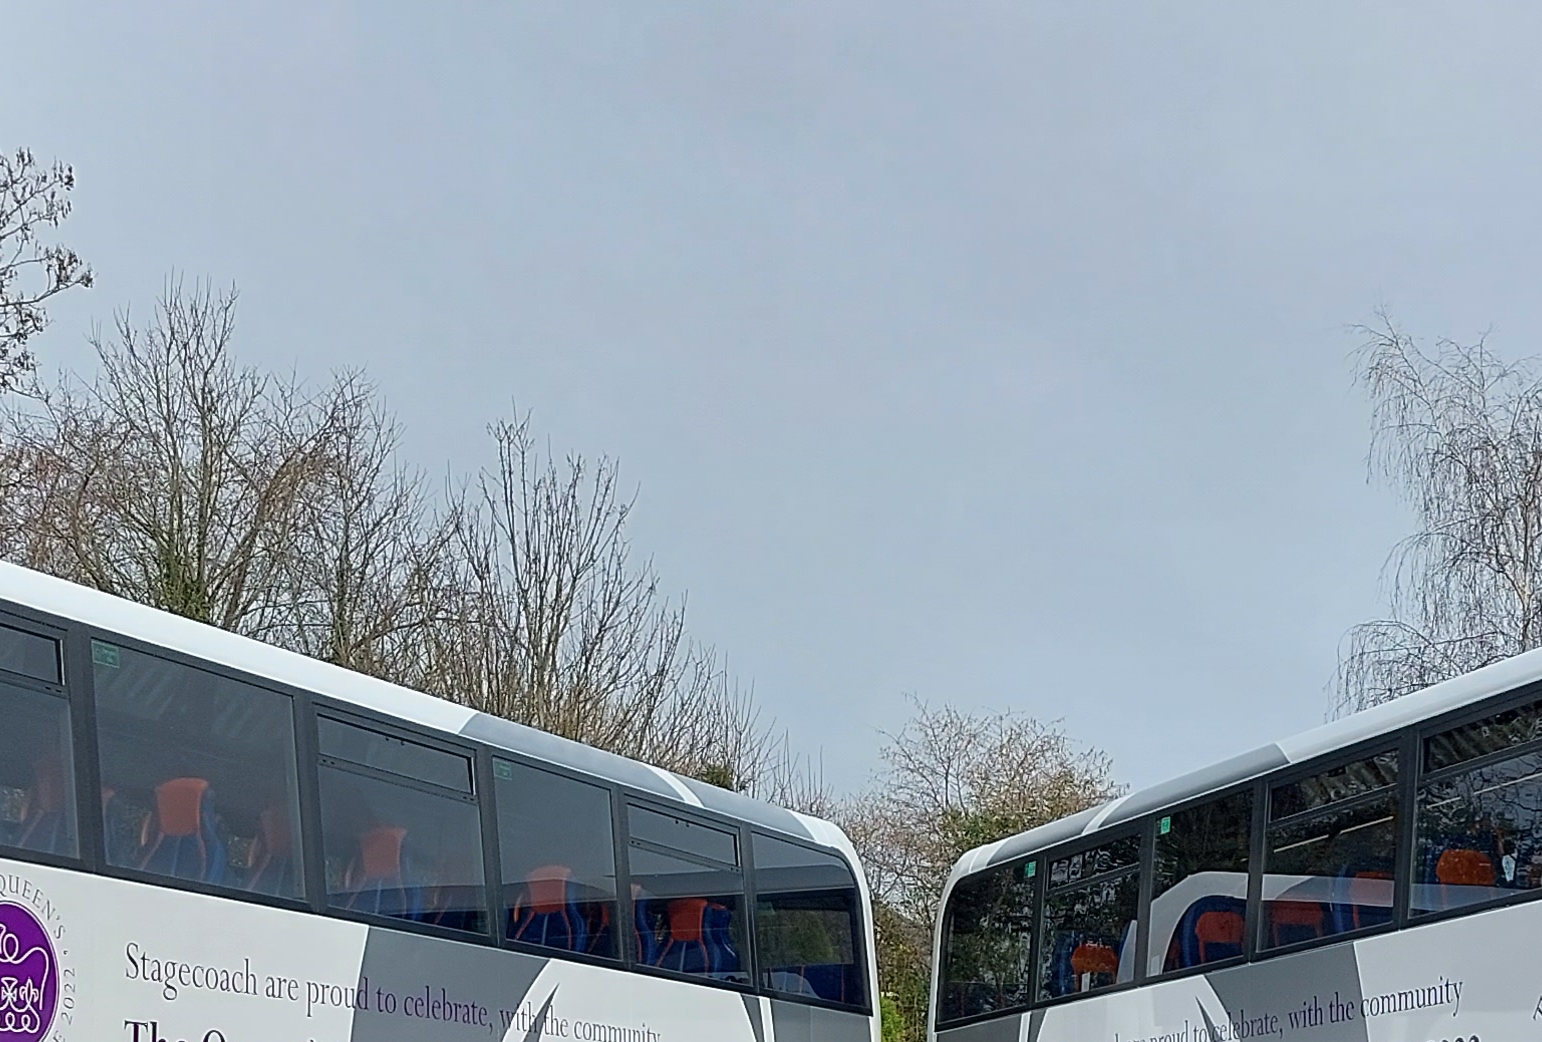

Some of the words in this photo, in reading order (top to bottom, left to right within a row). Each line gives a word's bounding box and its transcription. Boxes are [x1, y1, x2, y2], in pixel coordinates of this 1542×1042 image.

[60, 967, 76, 1025] 2022
[125, 942, 258, 1001] Stagecoach
[265, 975, 299, 1000] are
[307, 976, 368, 1017] proud
[376, 986, 396, 1014] to
[404, 985, 493, 1035] celebrate,
[499, 1001, 538, 1033] with
[544, 1004, 569, 1037] the
[1288, 996, 1323, 1029] with
[1329, 991, 1355, 1024] the
[1360, 976, 1463, 1017] community
